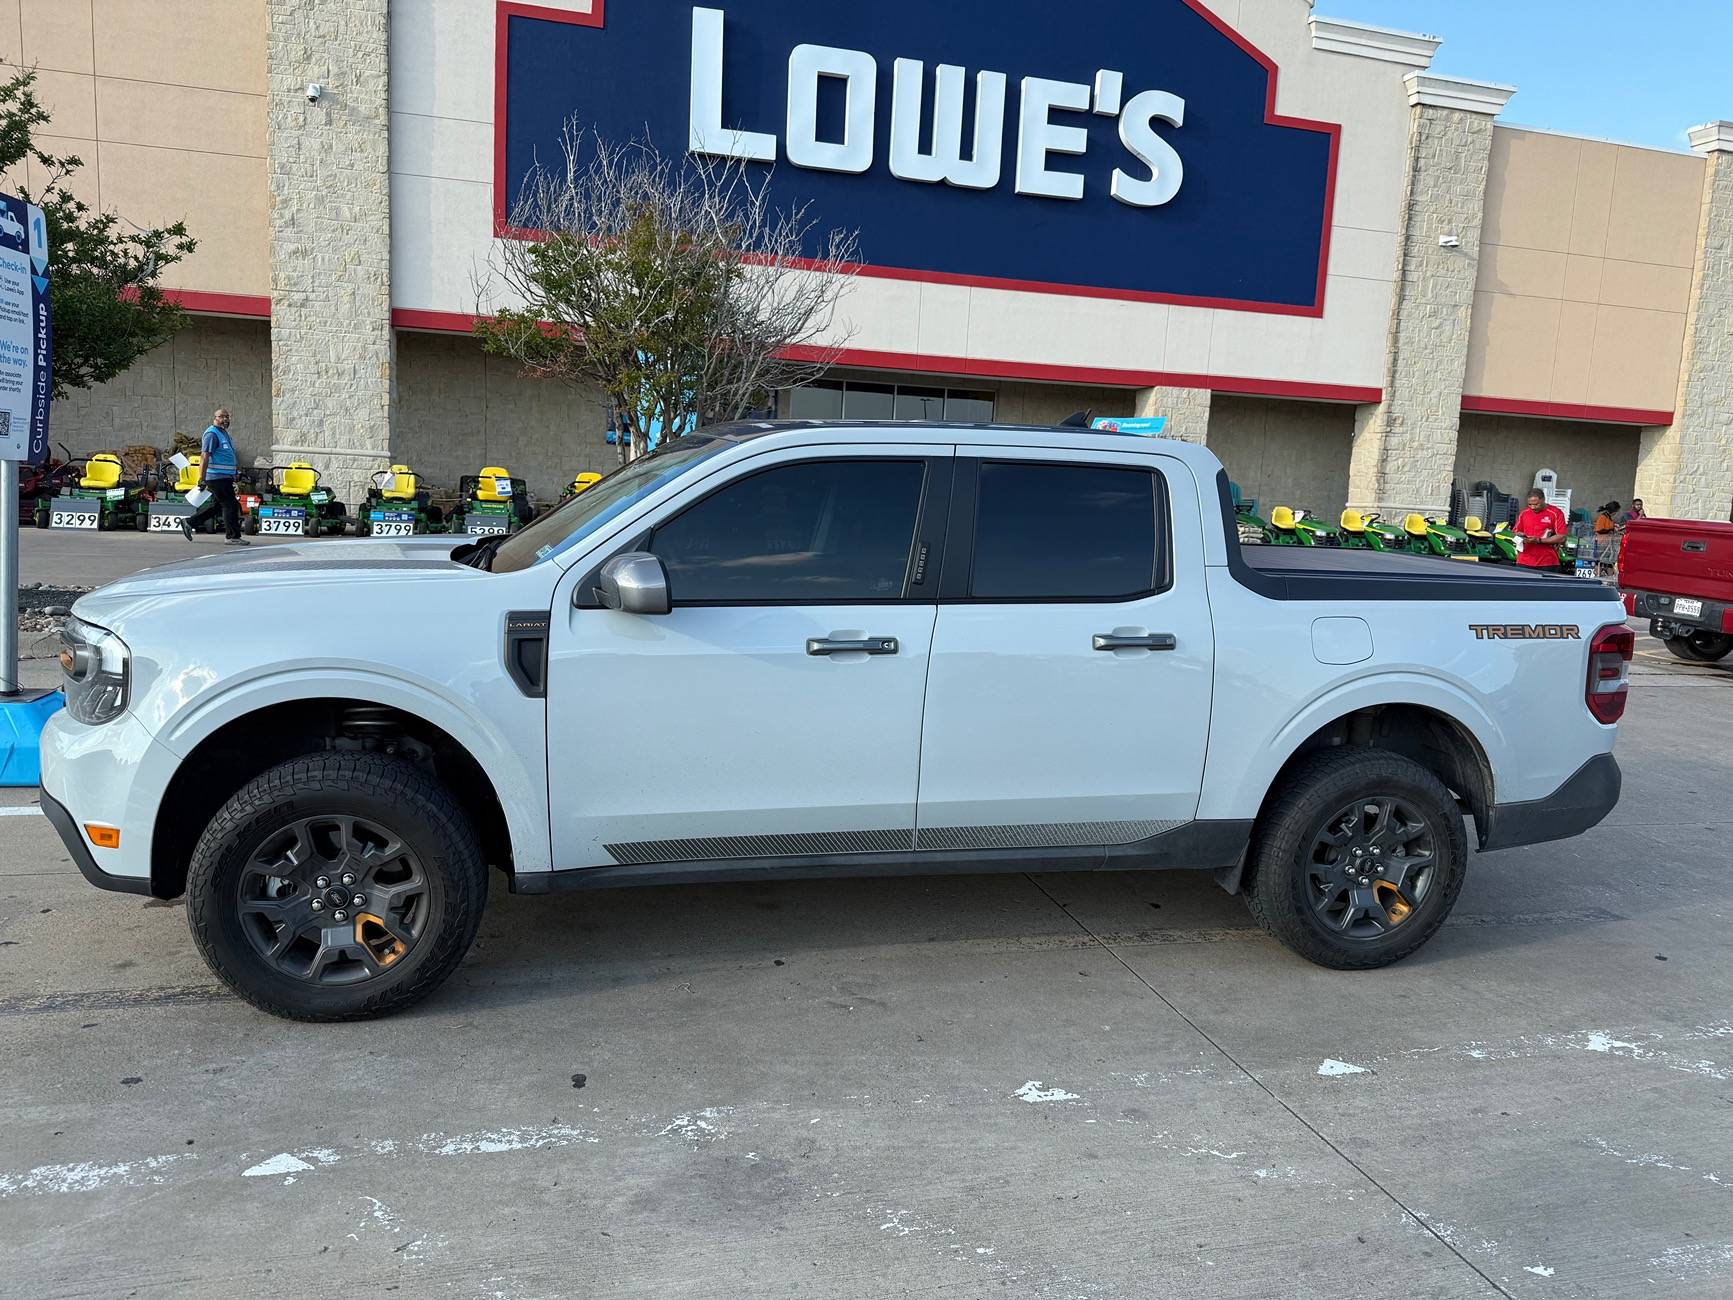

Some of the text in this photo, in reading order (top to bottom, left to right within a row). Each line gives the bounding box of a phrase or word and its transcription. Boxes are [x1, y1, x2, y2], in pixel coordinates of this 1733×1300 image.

[689, 6, 1185, 207] LOWE'S
[33, 217, 42, 248] 1
[20, 346, 28, 355] on
[33, 303, 47, 453] Curbside Pickup
[54, 513, 97, 526] 3299
[152, 516, 182, 529] 349
[264, 520, 301, 532] 3799
[375, 523, 412, 536] 3799
[1577, 569, 1596, 578] 269
[1468, 624, 1582, 640] TREMOR
